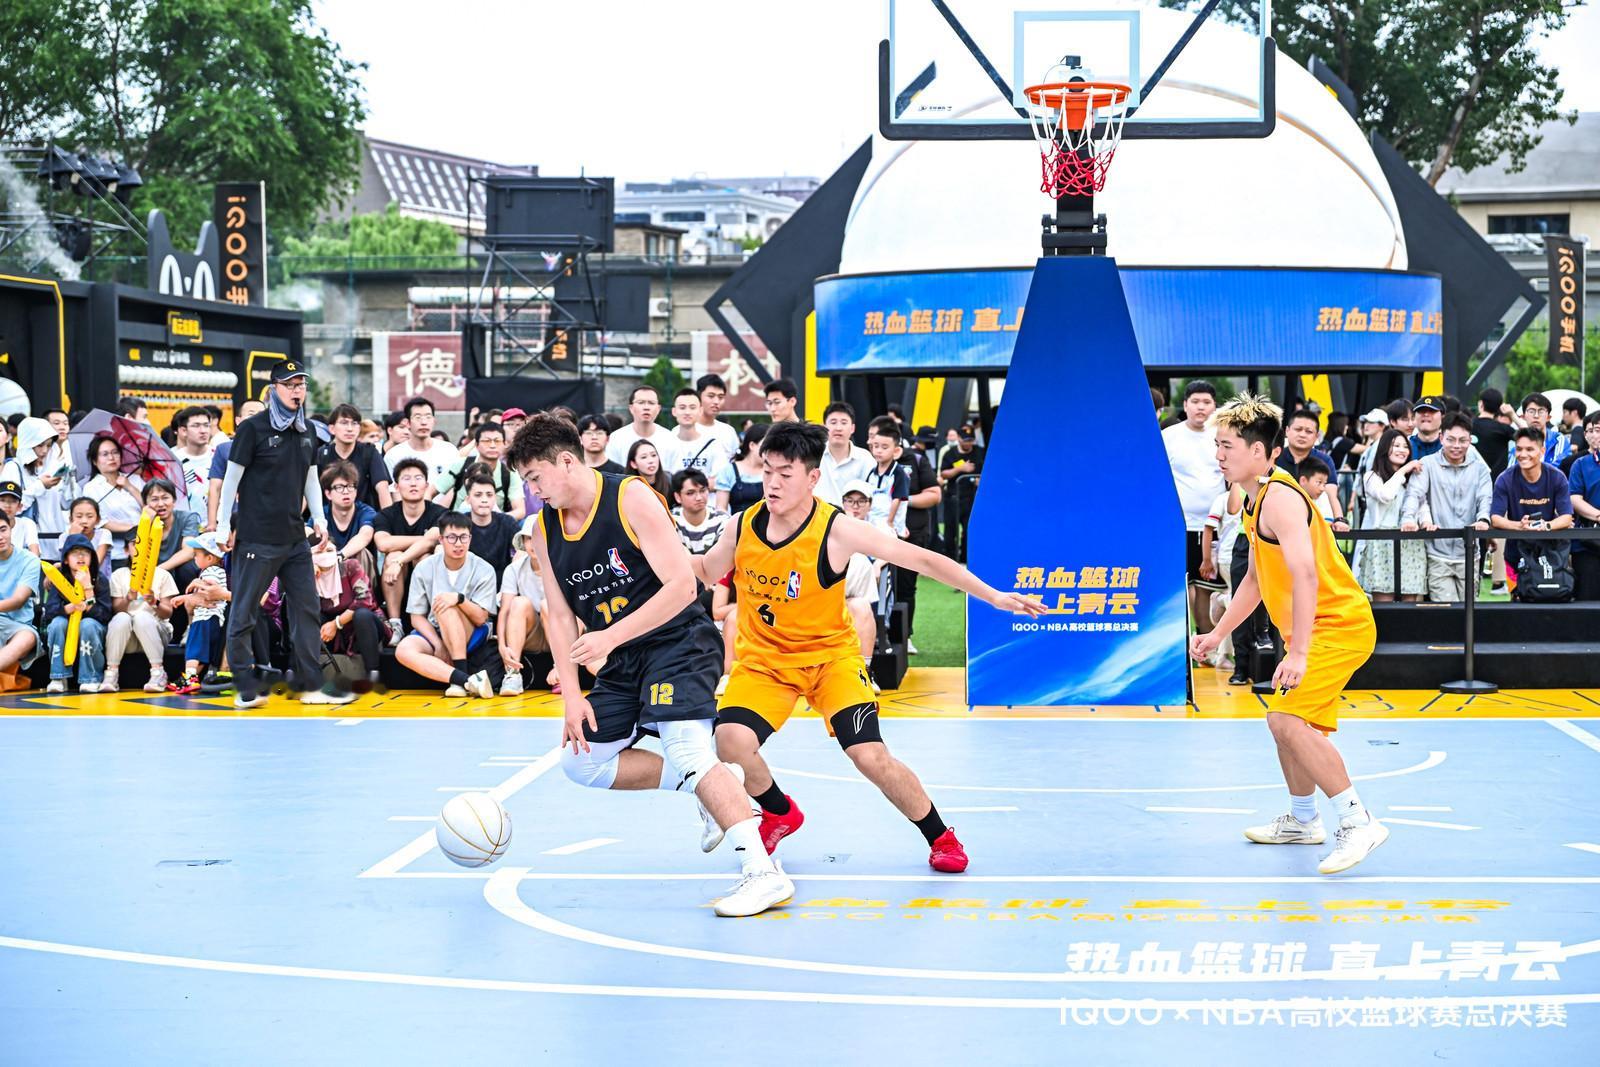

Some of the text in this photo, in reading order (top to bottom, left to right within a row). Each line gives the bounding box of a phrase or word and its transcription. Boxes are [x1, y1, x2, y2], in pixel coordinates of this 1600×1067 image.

[863, 308, 964, 335] 热血篮球
[1315, 306, 1407, 333] 热血篮球
[396, 348, 465, 398] 德
[565, 563, 604, 586] iQOO
[1013, 566, 1141, 589] 热血篮球
[757, 603, 776, 627] 6
[650, 682, 674, 706] 12
